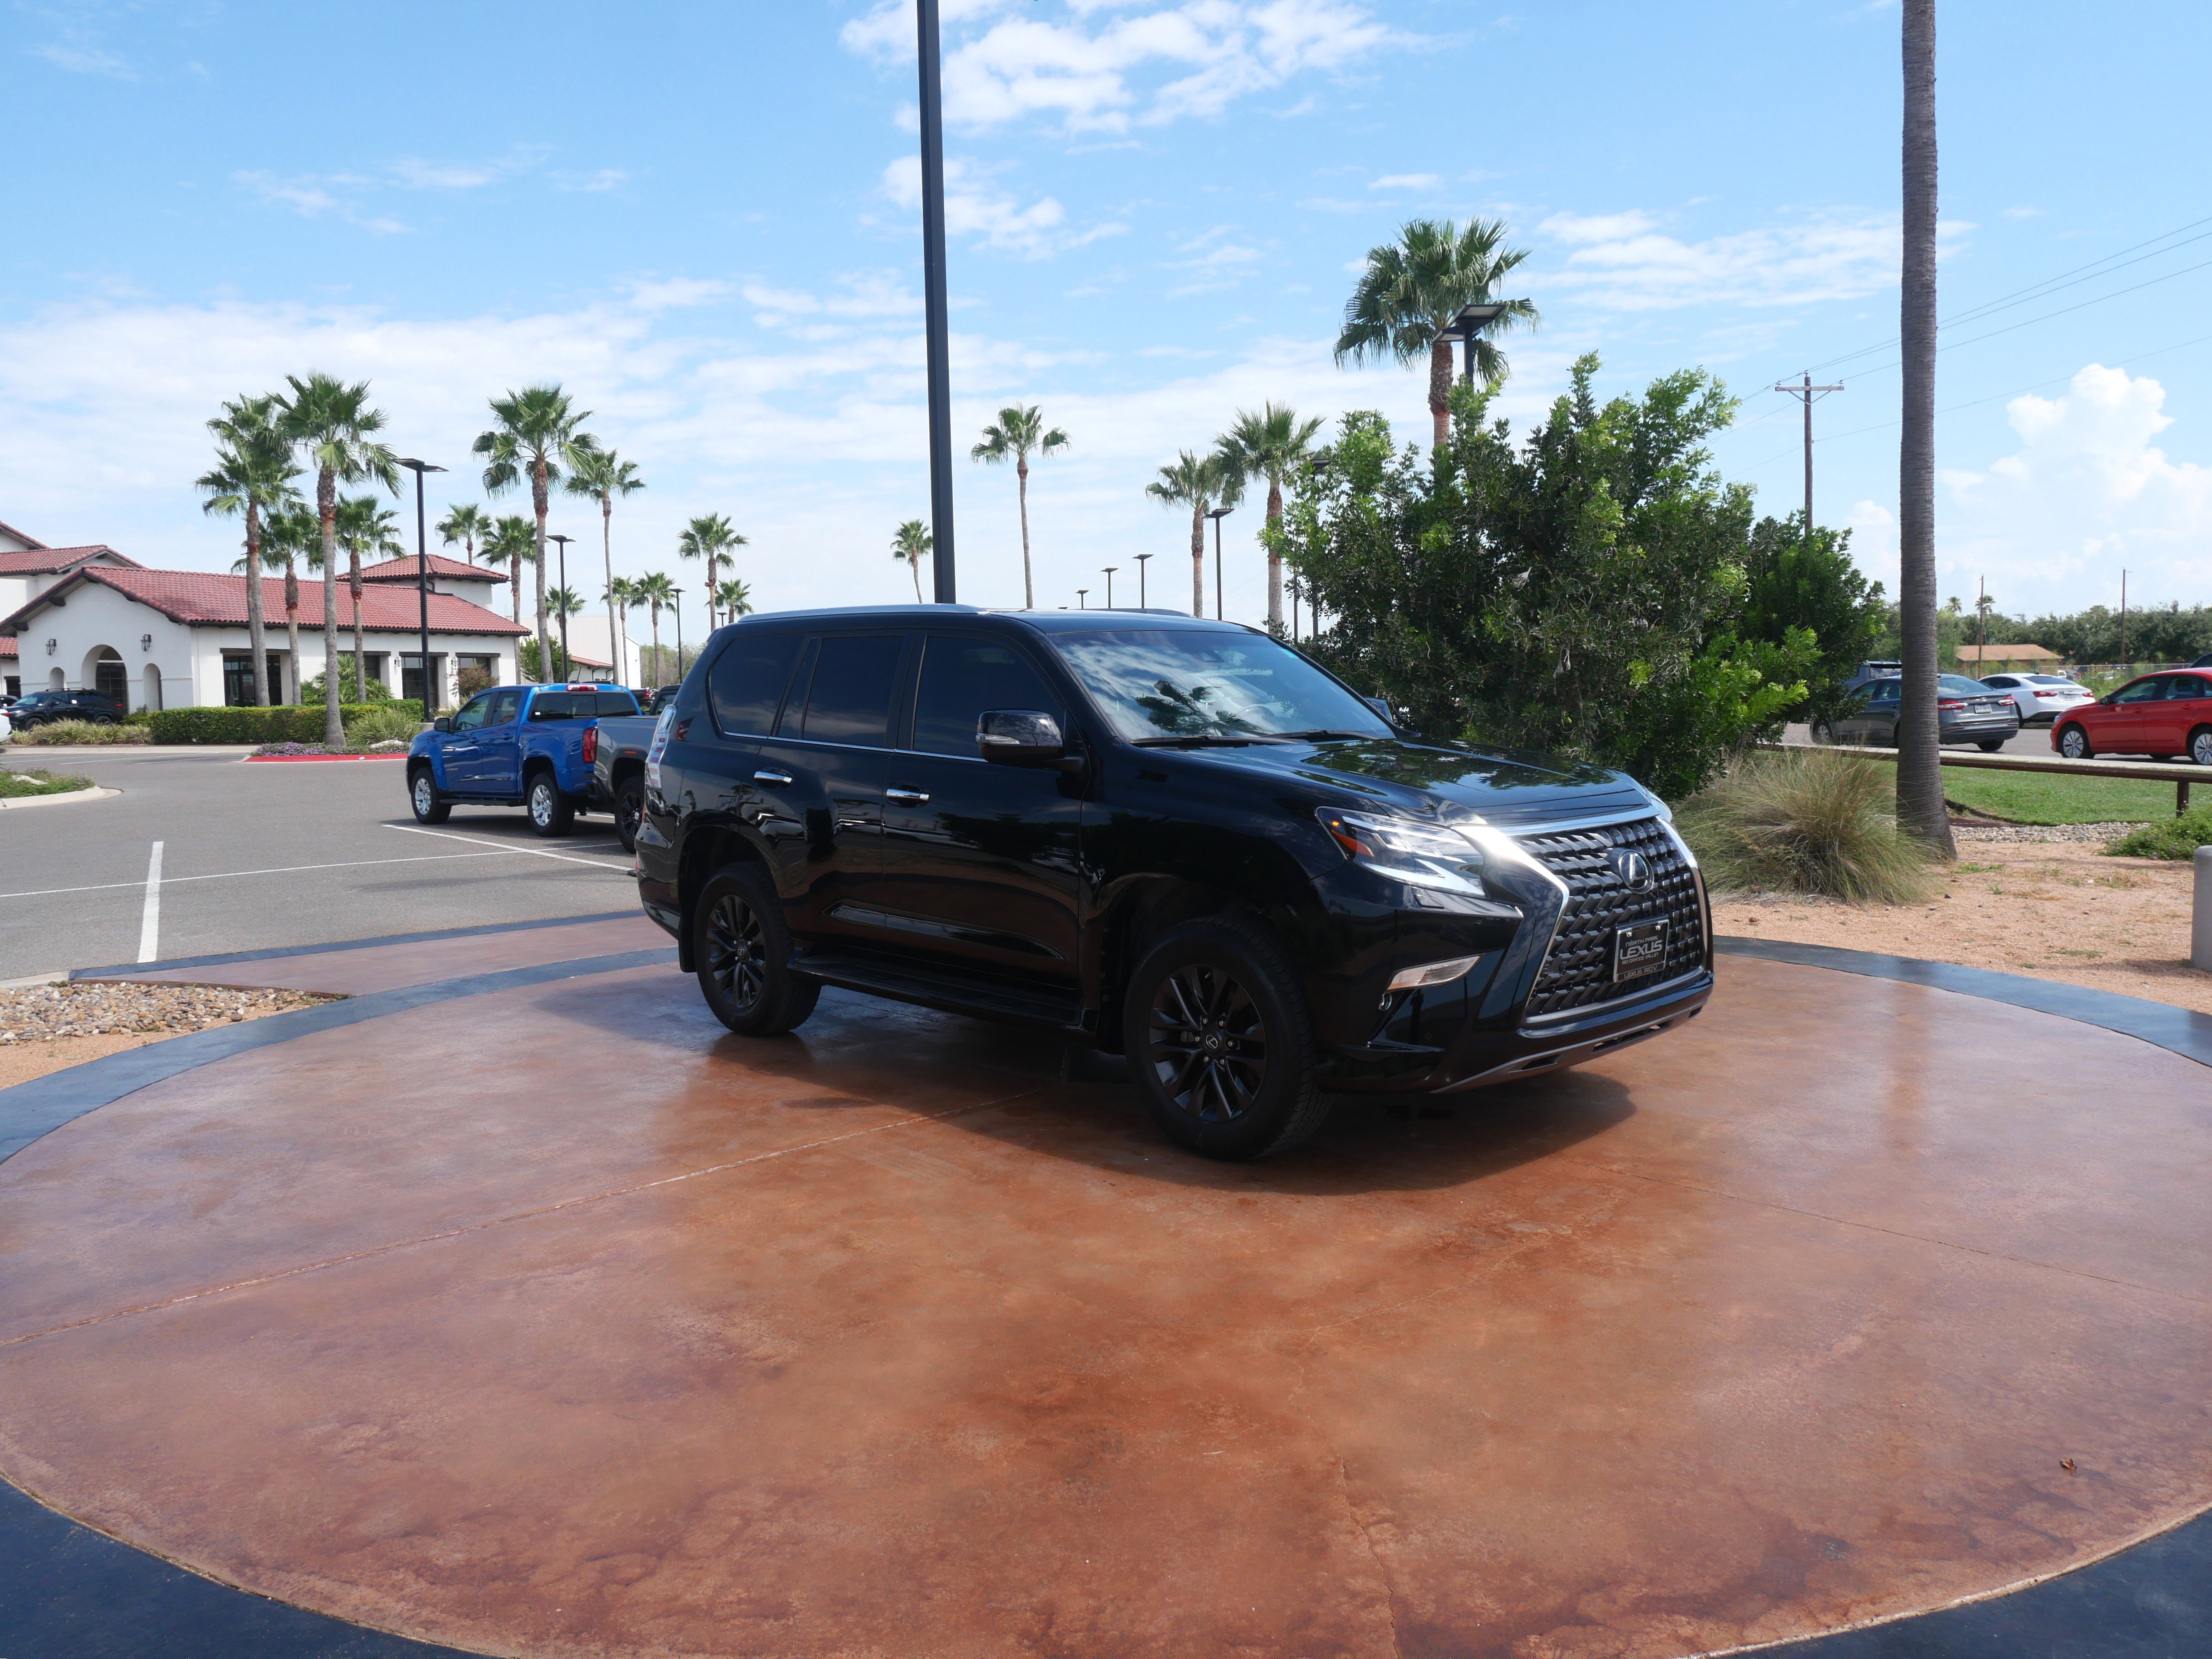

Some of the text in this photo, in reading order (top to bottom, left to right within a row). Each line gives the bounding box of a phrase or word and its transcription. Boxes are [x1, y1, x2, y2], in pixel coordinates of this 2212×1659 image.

[1620, 940, 1663, 960] LEXUS
[1624, 965, 1658, 979] LEXUS RGV
